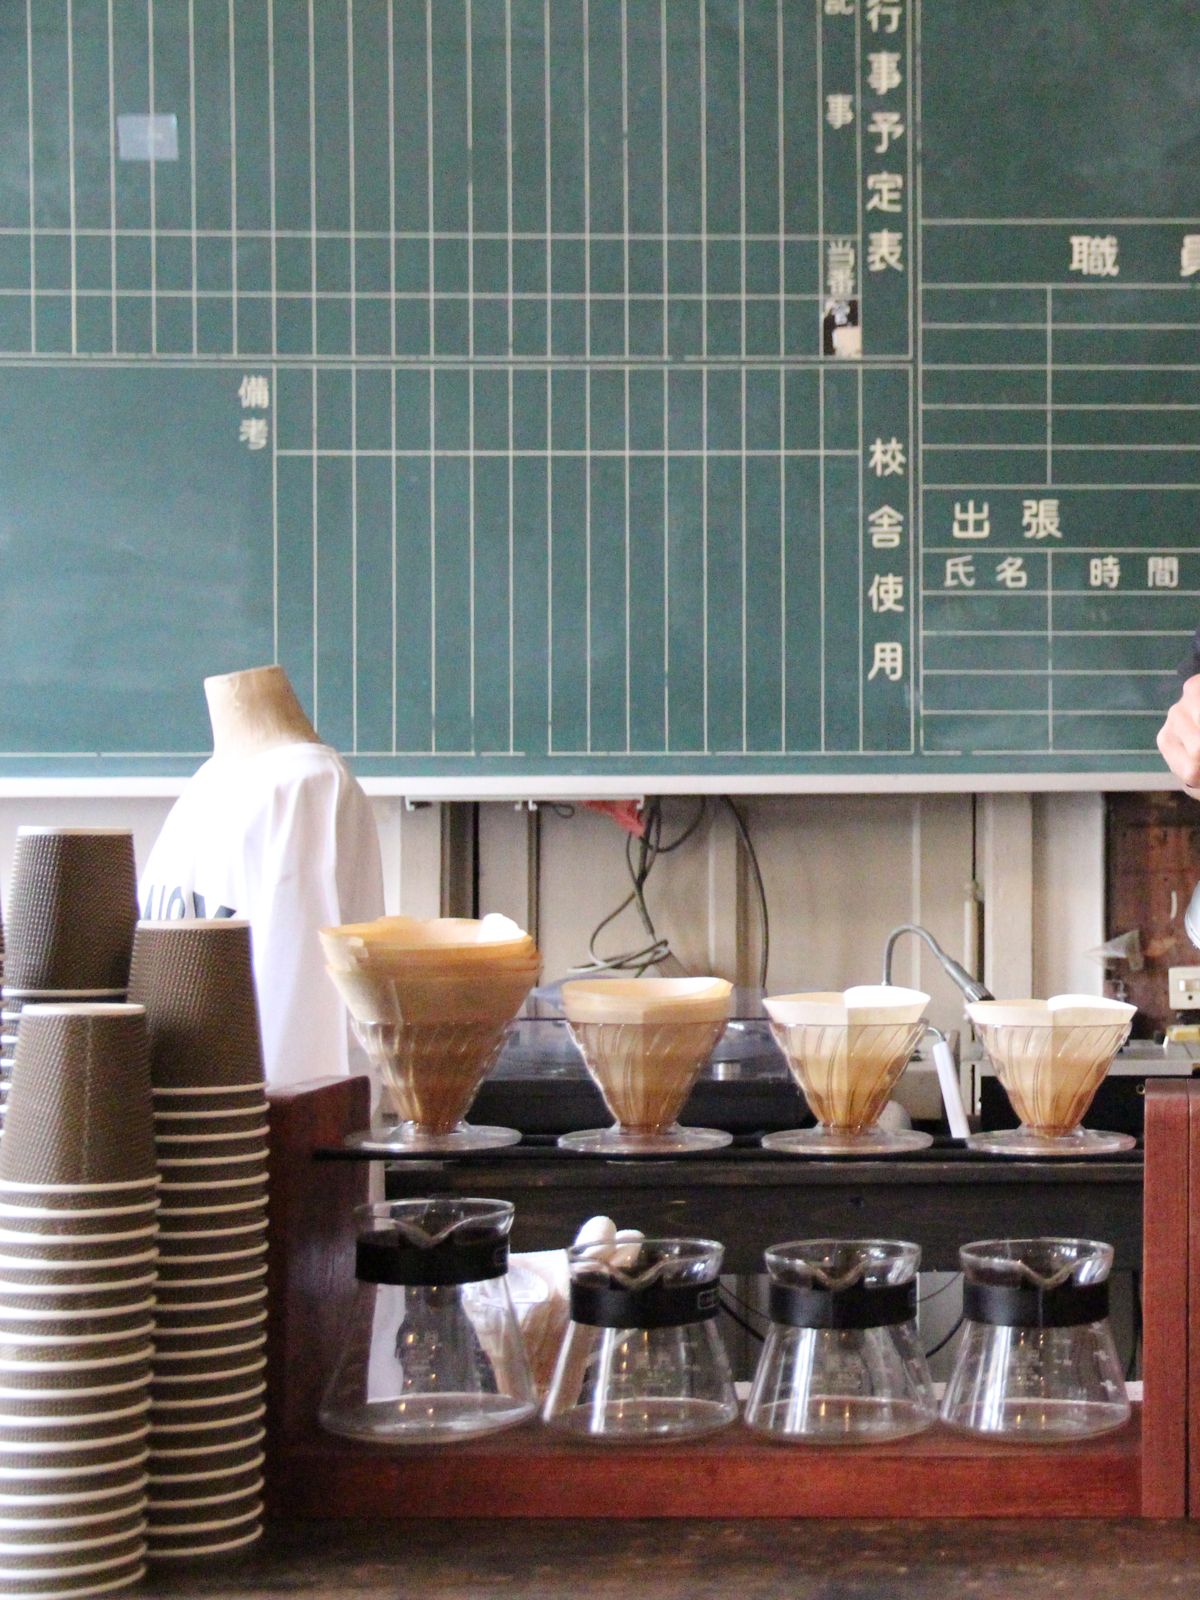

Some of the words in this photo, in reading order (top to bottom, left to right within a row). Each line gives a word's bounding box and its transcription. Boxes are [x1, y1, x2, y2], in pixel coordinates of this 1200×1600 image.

[866, 0, 904, 271] 行事予定表
[238, 374, 269, 450] 備考
[952, 499, 1062, 539] 出張
[867, 437, 906, 681] 校舎使用
[944, 555, 1028, 588] 氏名
[1089, 555, 1179, 588] 時間
